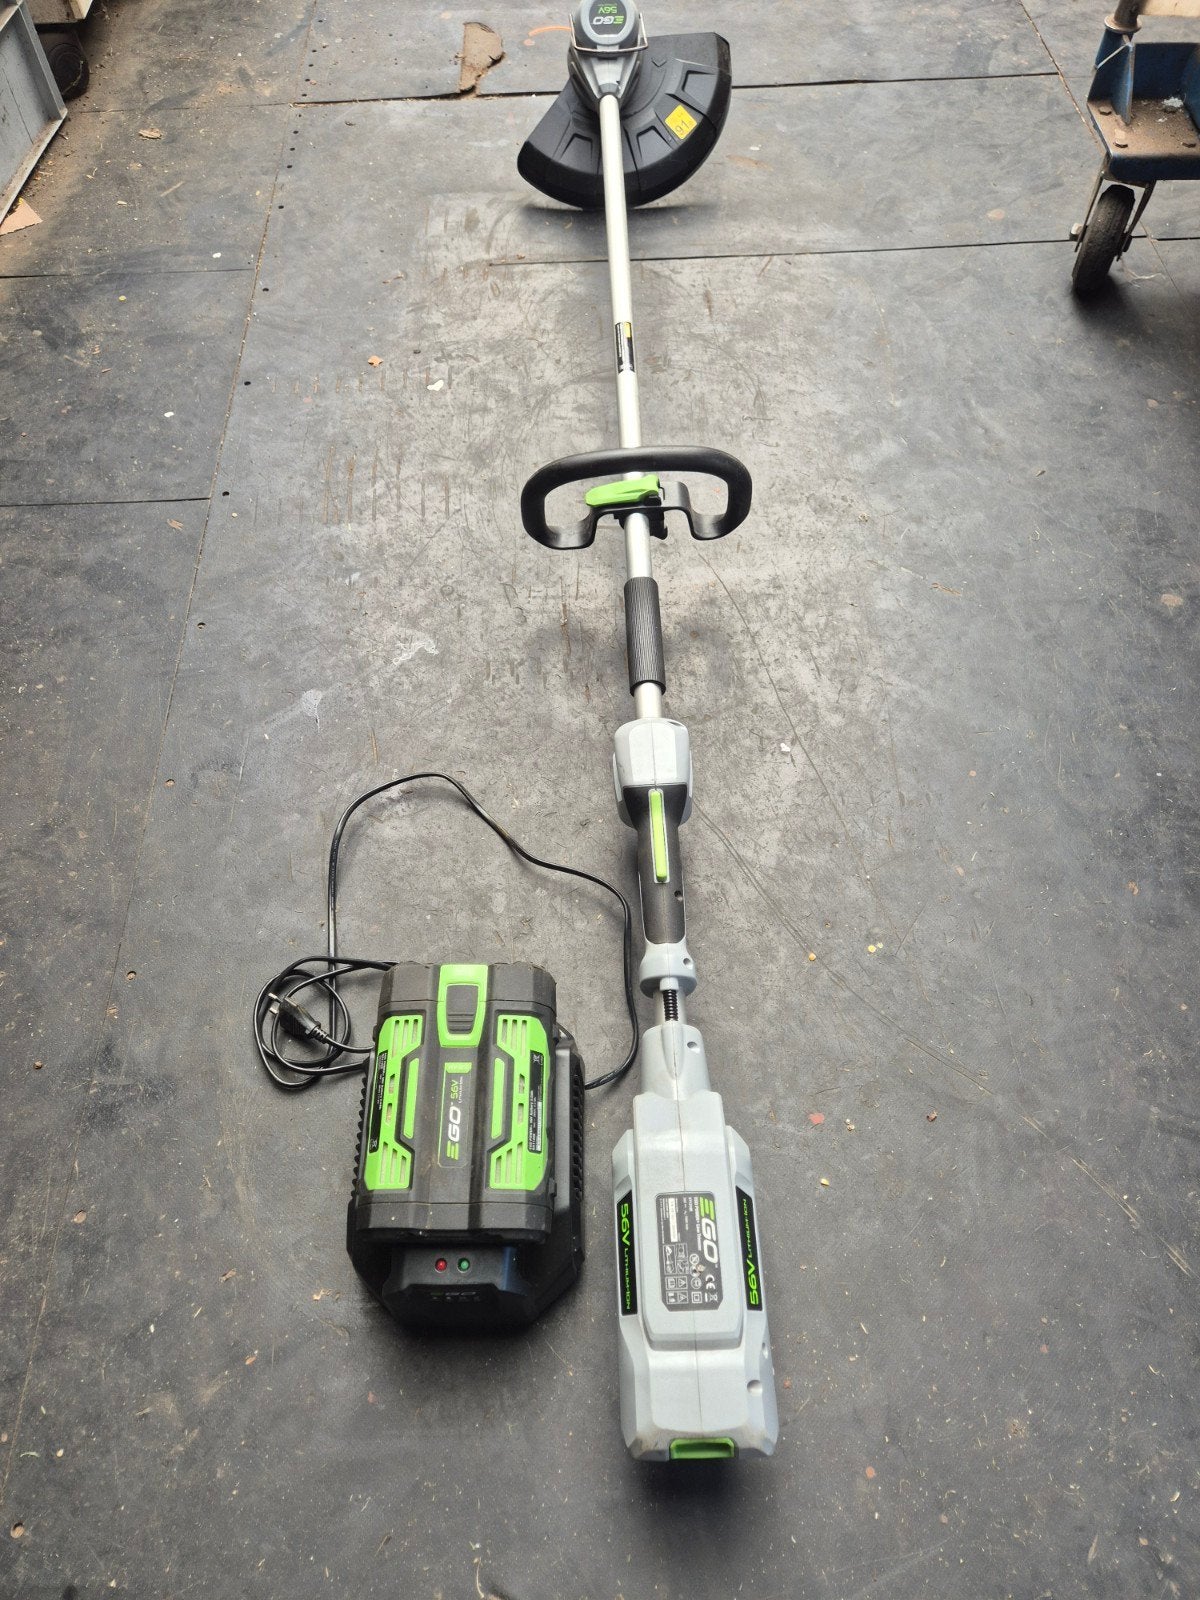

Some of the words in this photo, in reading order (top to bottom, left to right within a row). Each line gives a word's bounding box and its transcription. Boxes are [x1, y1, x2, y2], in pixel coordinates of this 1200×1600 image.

[592, 15, 625, 25] EGO
[598, 6, 618, 14] 56V
[450, 1079, 459, 1100] 56V
[446, 1105, 462, 1161] EGO
[620, 1203, 631, 1247] 56V
[699, 1196, 719, 1264] EGO
[742, 1198, 753, 1258] LITHIUM-ION
[746, 1259, 759, 1305] 56V
